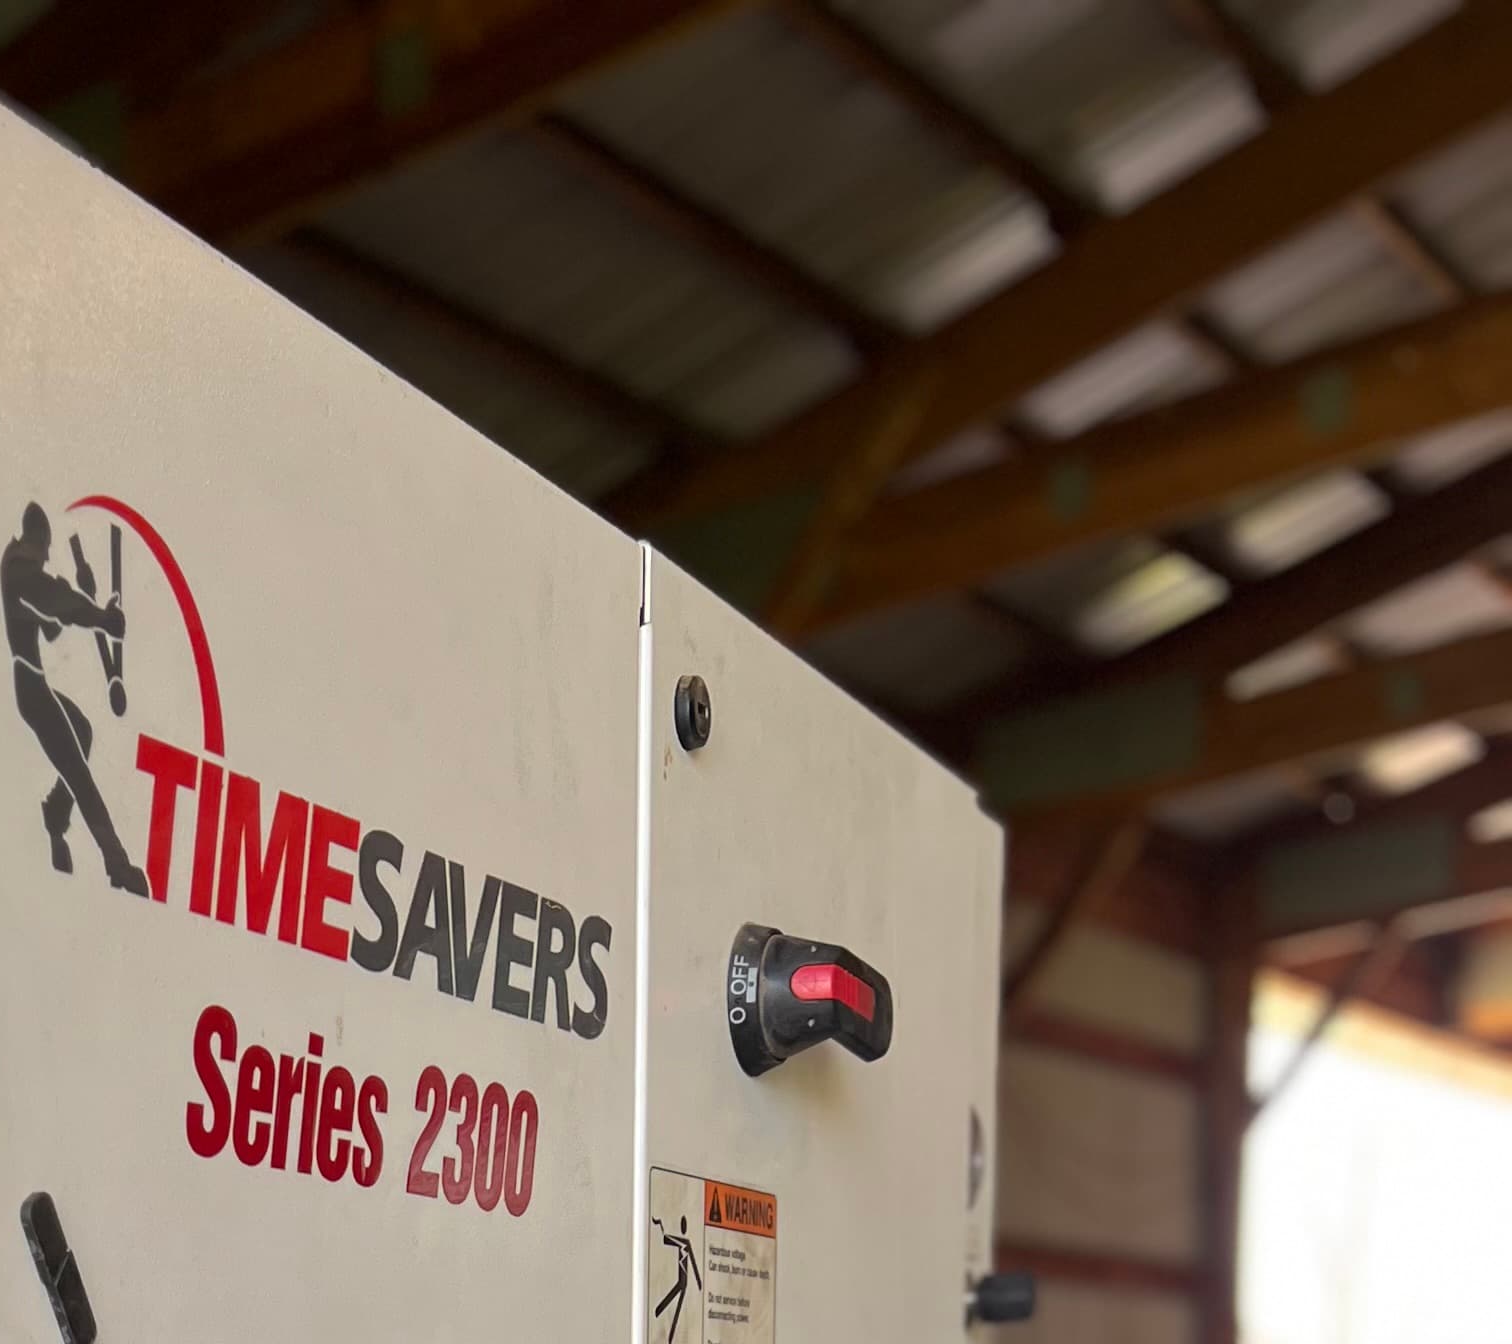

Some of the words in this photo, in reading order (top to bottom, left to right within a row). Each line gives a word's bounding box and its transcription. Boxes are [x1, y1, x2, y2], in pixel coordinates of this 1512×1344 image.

[136, 733, 612, 1039] TIMESAVERS
[730, 954, 749, 995] OFF
[187, 1005, 388, 1187] Series
[406, 1065, 538, 1217] 2300
[724, 1191, 774, 1229] WARNING
